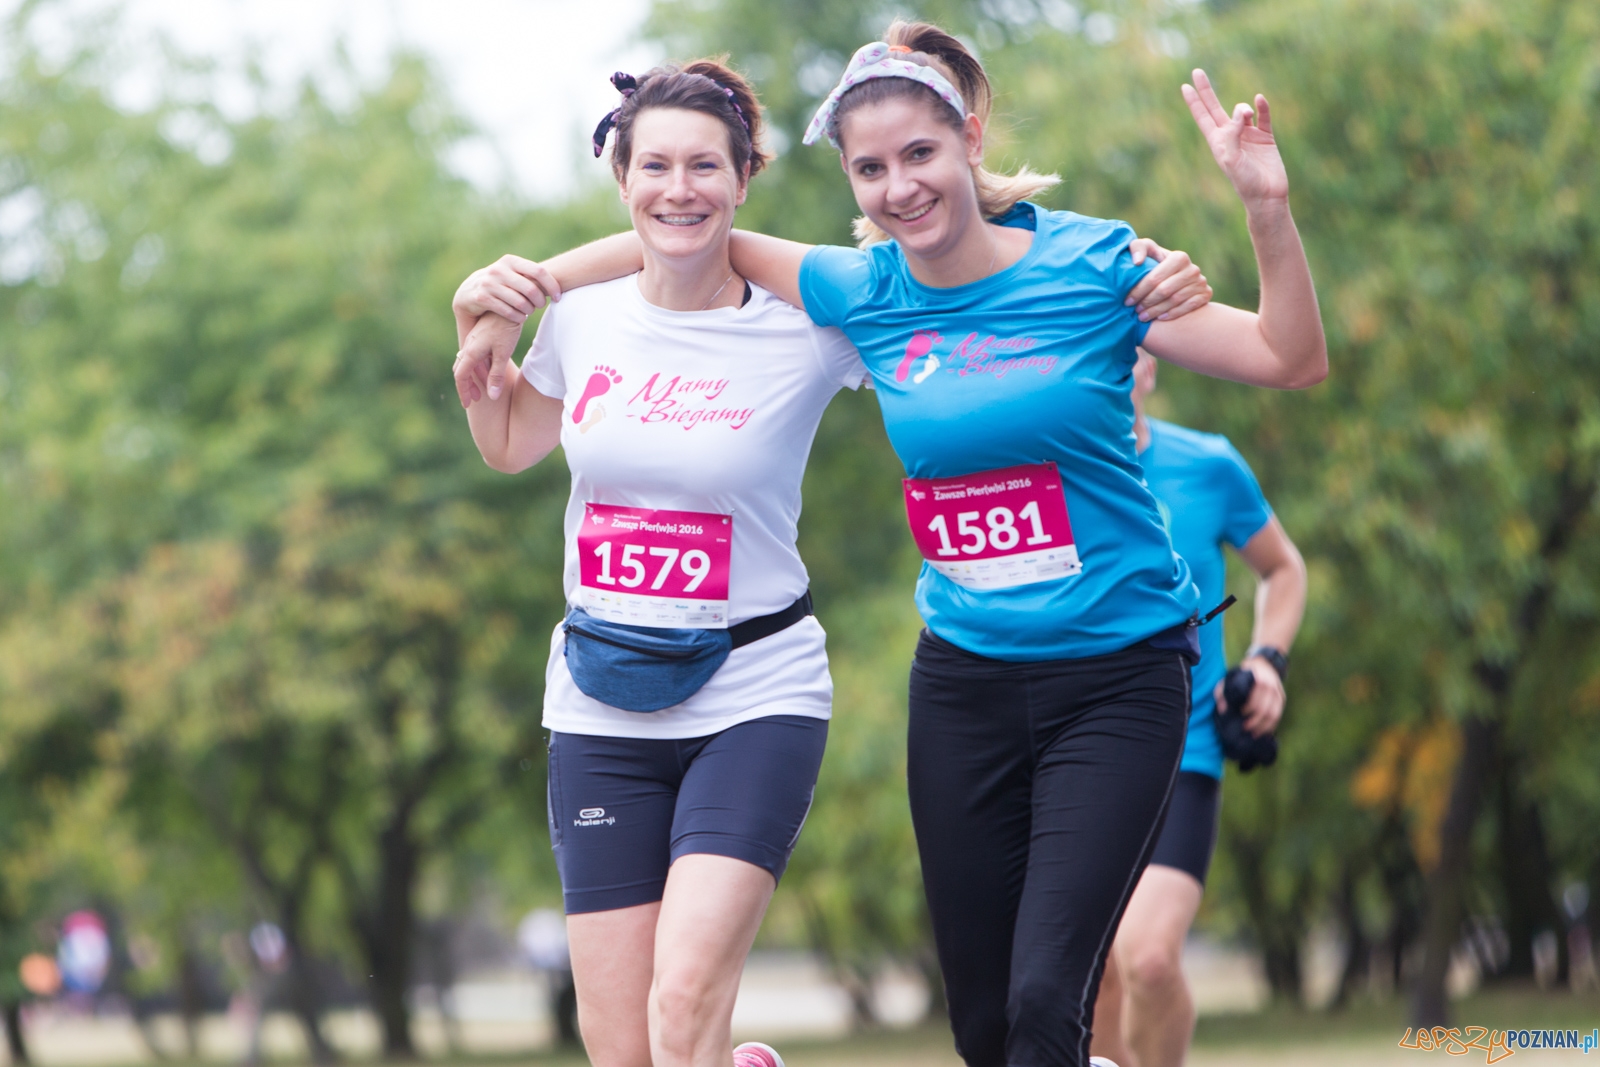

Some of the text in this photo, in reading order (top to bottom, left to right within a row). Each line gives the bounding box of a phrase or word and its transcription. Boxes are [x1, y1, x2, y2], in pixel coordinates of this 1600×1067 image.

[627, 372, 730, 406] Mamy
[639, 398, 756, 431] Biegamy
[933, 488, 966, 501] Zawsze
[966, 482, 1006, 497] Pier(w)si
[1006, 477, 1032, 490] 2016
[611, 518, 638, 530] Zawsze
[639, 521, 677, 533] Pier(w)si
[678, 524, 704, 535] 2016
[927, 500, 1053, 557] 1581
[593, 540, 711, 593] 1579
[573, 816, 616, 827] Kalenji
